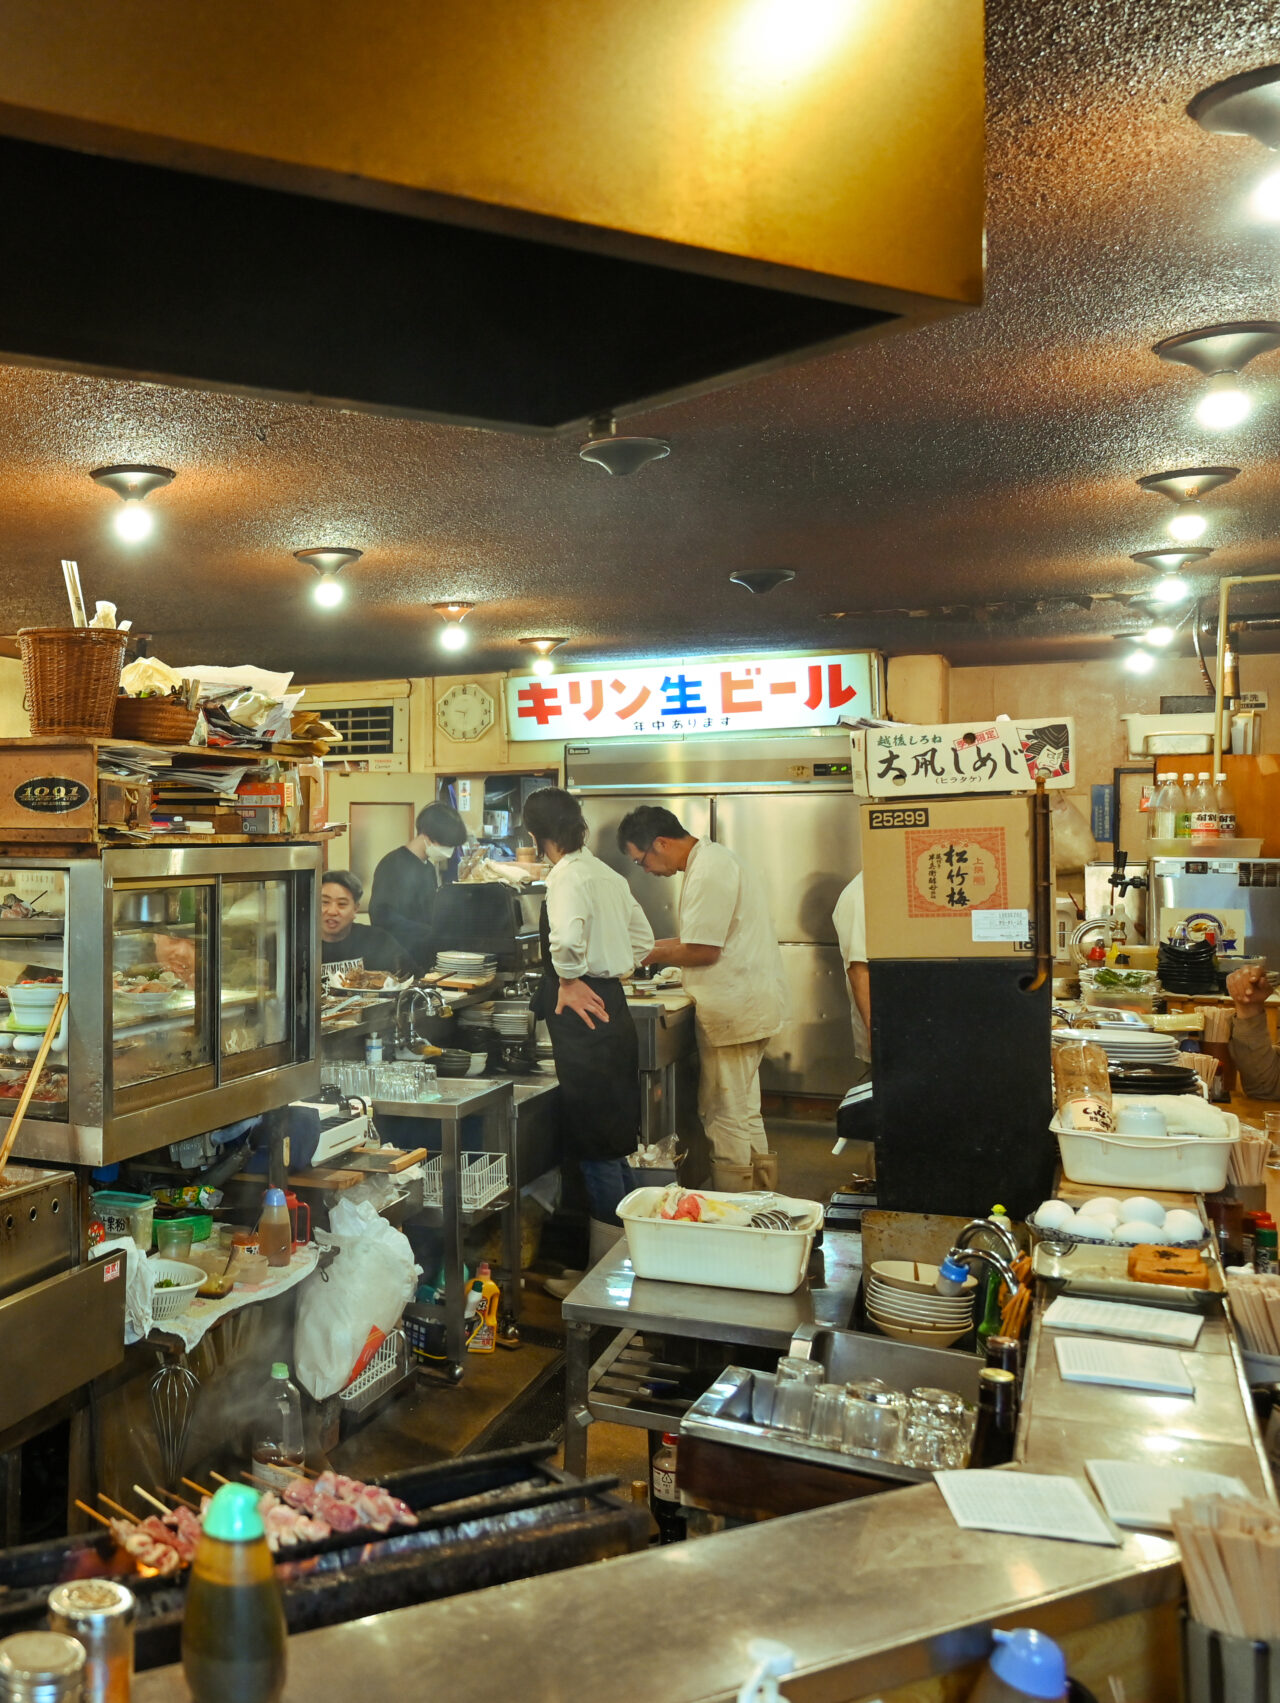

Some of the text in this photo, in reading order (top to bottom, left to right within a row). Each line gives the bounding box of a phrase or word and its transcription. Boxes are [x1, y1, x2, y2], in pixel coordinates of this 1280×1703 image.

[517, 663, 857, 726] キリン生ビール
[632, 717, 732, 732] 年中あります
[877, 733, 943, 749] 越後しろね
[955, 730, 997, 750] 季限定
[935, 775, 982, 784] (ヒラタケ)
[872, 811, 926, 827] 25299
[944, 844, 970, 907] 松竹梅
